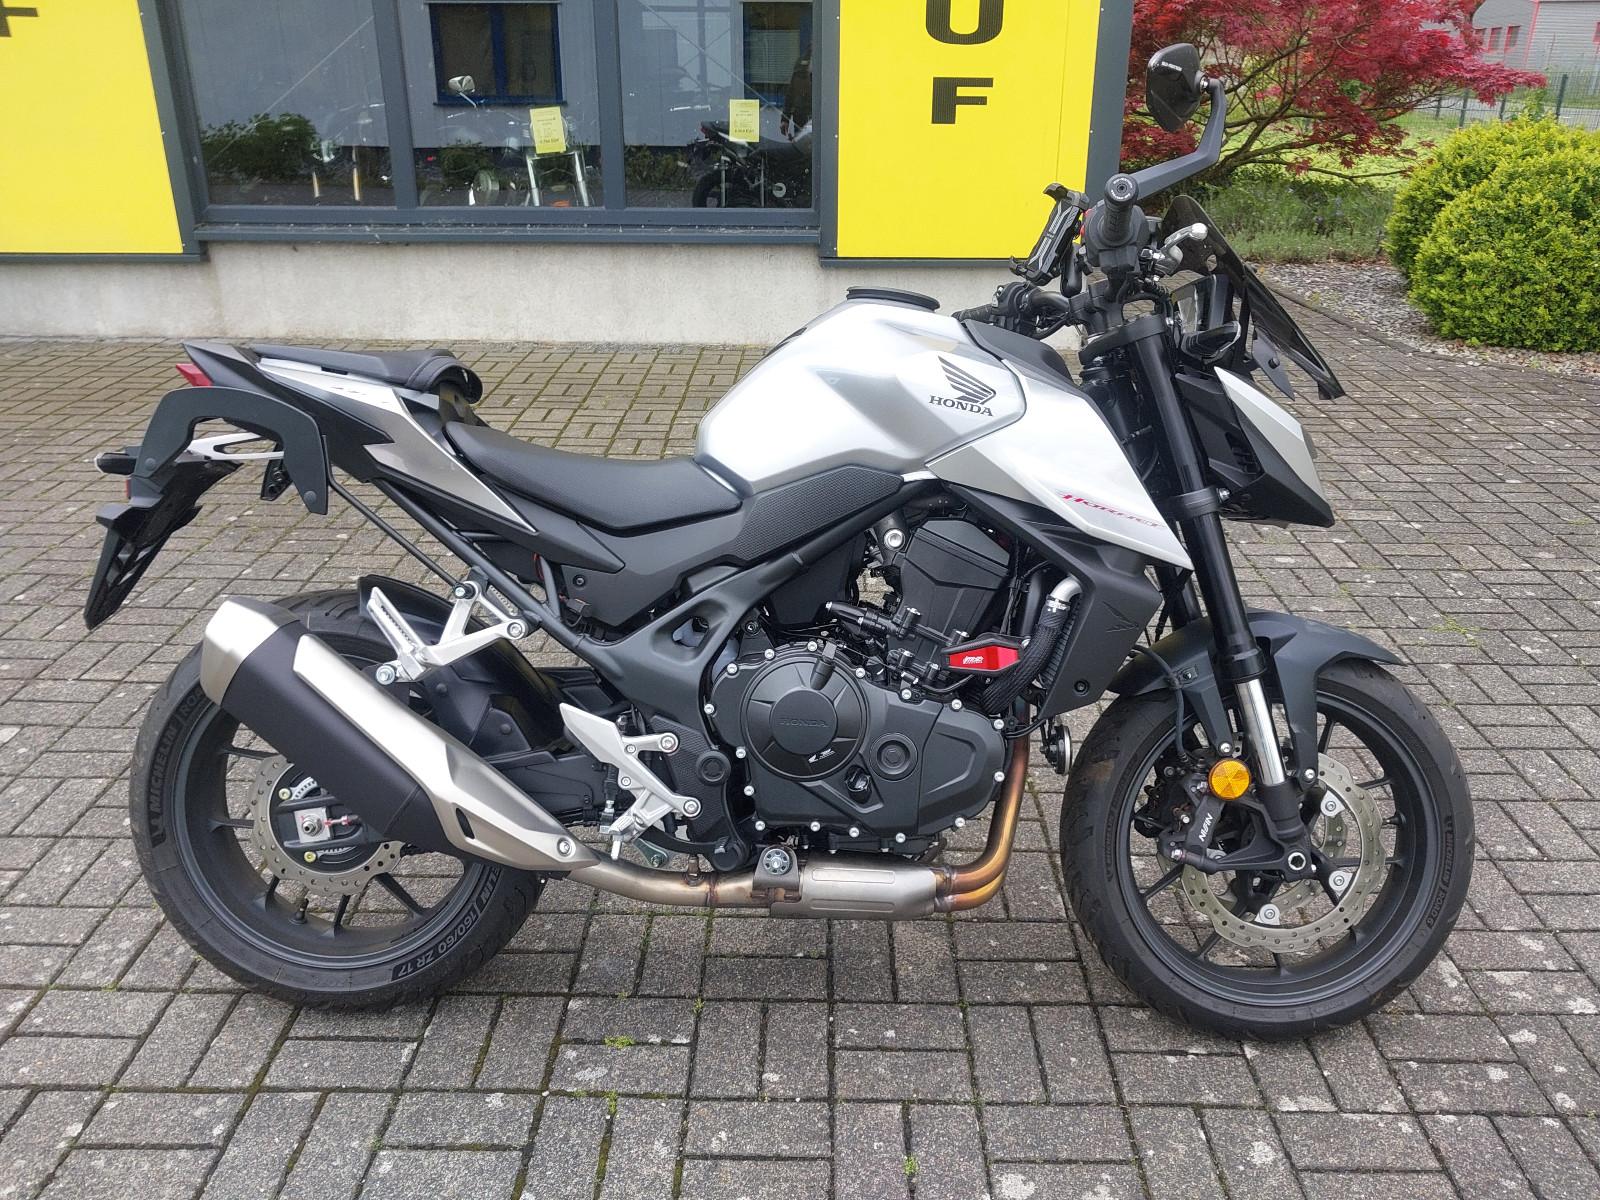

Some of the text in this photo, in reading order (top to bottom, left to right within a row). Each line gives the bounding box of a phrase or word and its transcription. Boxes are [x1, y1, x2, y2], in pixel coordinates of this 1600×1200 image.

[929, 395, 993, 416] HONDA
[150, 726, 178, 813] MICHELIN
[1198, 812, 1213, 842] NISSIN
[438, 910, 477, 953] 160/60
[398, 963, 415, 977] 17
[417, 949, 435, 967] ZR
